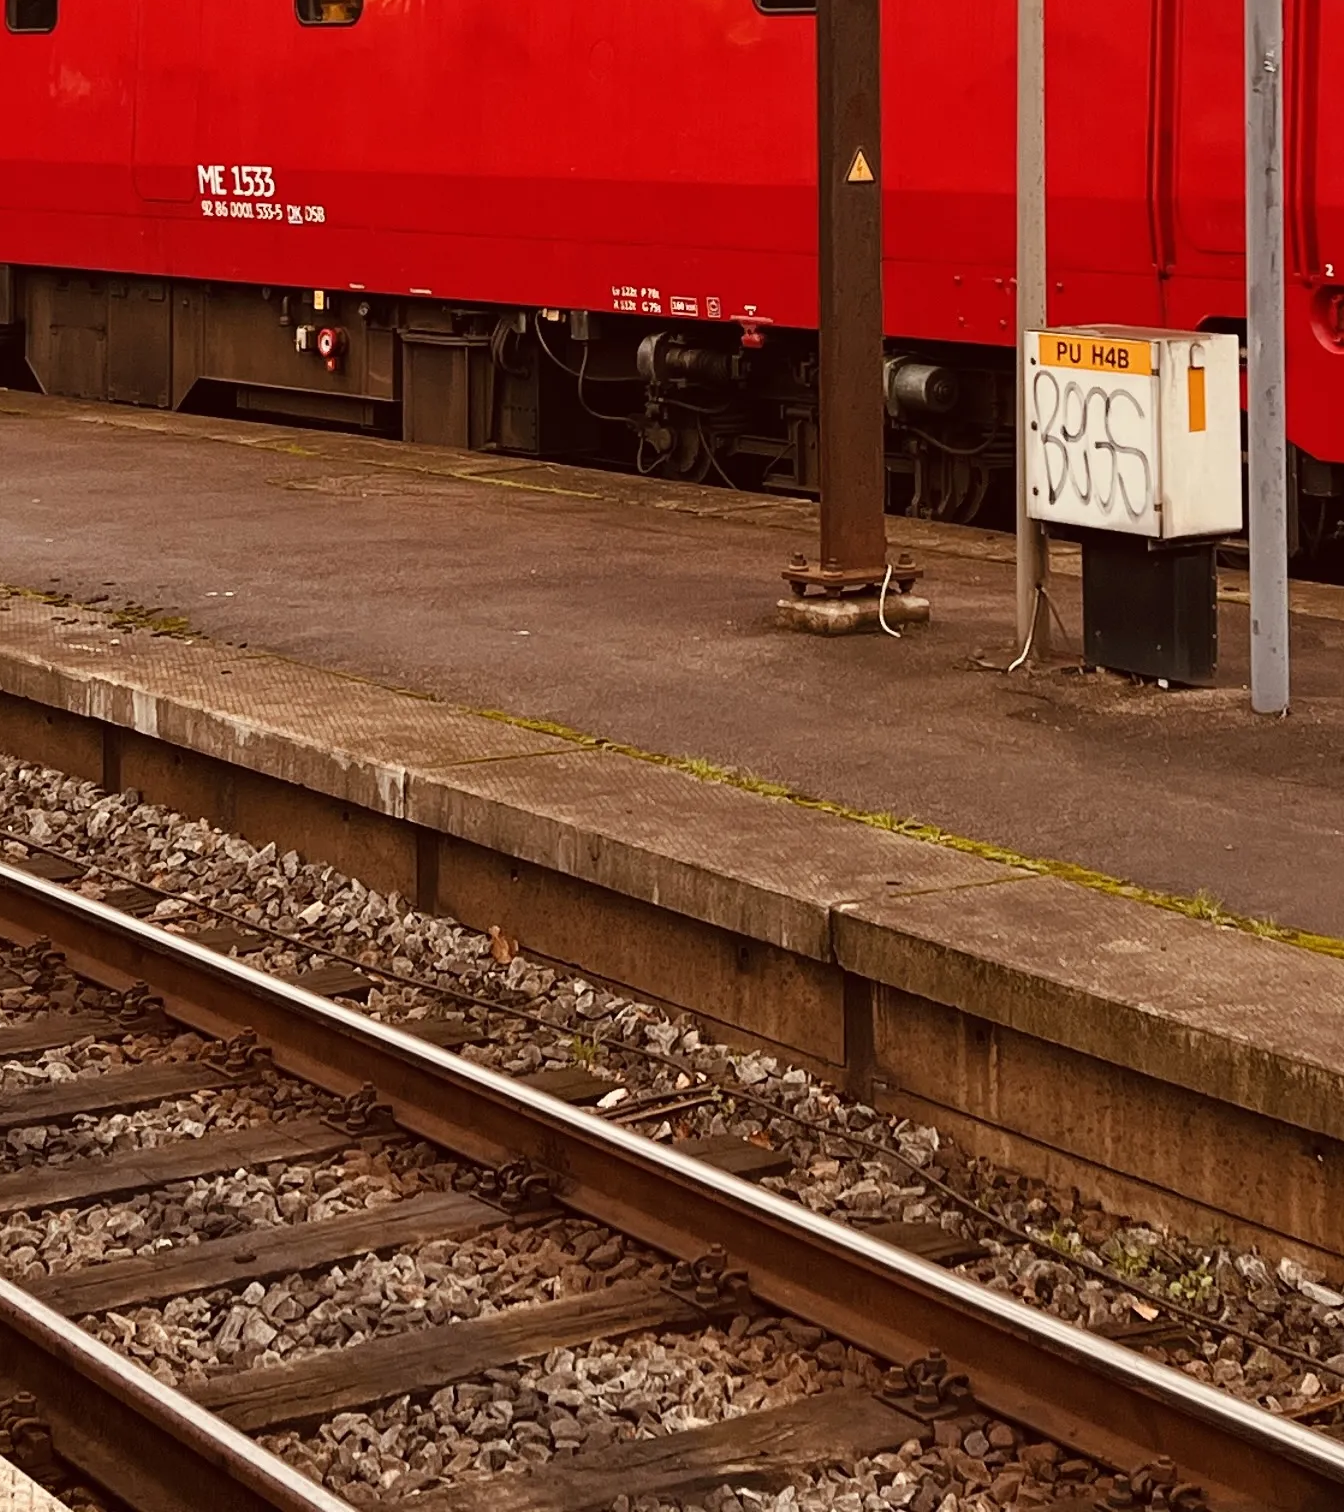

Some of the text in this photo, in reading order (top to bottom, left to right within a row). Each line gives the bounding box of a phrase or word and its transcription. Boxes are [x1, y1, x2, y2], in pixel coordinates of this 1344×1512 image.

[197, 164, 275, 197] ME 1533
[201, 200, 214, 217] 92
[215, 201, 229, 217] 86
[305, 206, 326, 223] DSB
[1325, 263, 1335, 277] 2
[1057, 341, 1130, 370] PU H4B
